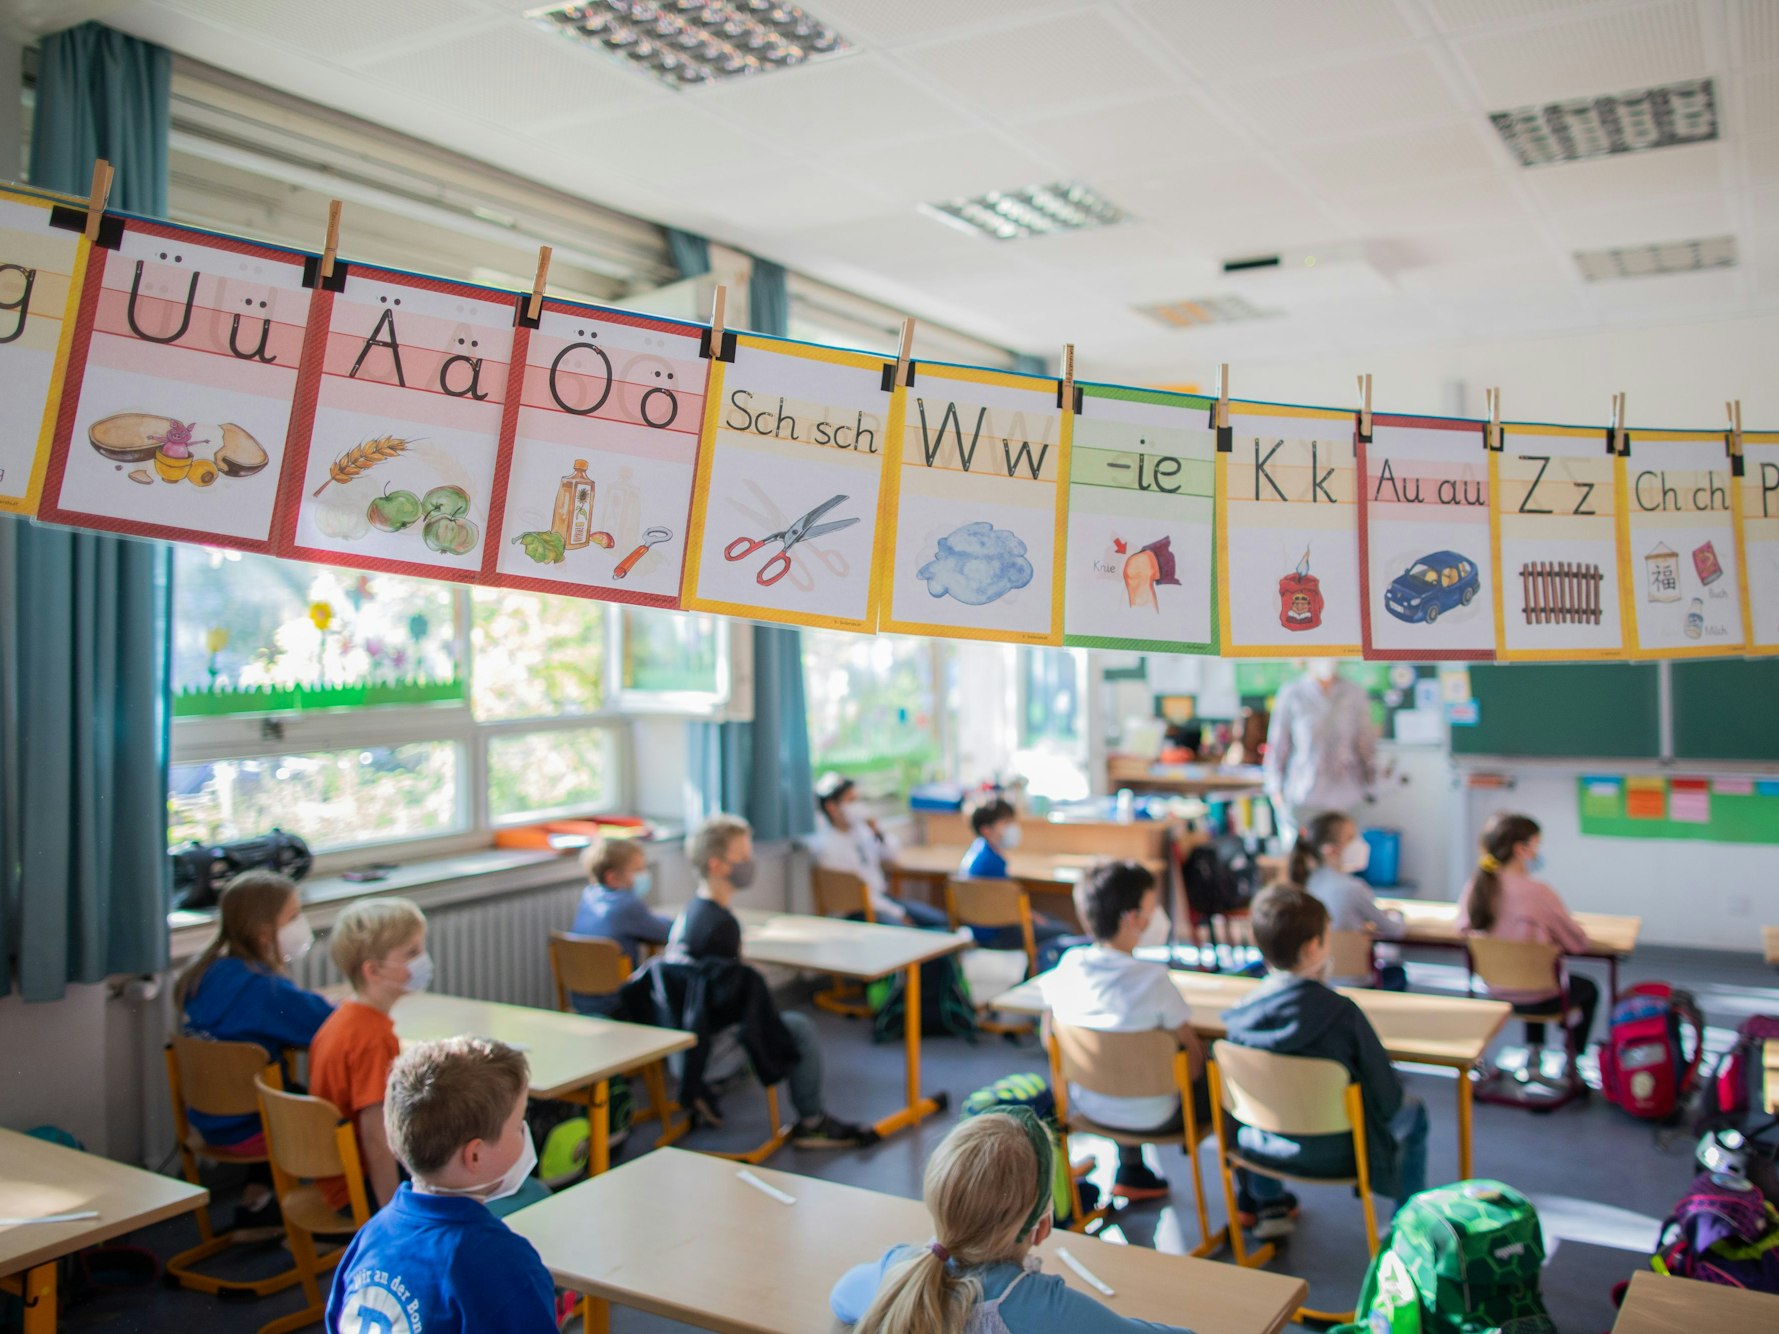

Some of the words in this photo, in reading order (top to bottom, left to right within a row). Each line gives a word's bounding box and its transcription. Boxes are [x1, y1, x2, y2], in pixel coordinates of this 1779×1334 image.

[128, 252, 200, 344] Ü
[230, 298, 277, 363] ü
[349, 296, 406, 387] Ä
[440, 338, 488, 400] ä
[549, 330, 612, 415] Ö
[641, 371, 678, 428] ö
[726, 390, 799, 440] Sch
[814, 411, 877, 453] sch
[917, 398, 987, 472] W
[1003, 439, 1049, 480] w
[1254, 438, 1288, 501] K
[1312, 440, 1337, 503] k
[1374, 458, 1424, 503] Au
[1438, 479, 1485, 505] au
[1518, 455, 1553, 514] Z
[1573, 482, 1596, 515] z
[1635, 470, 1682, 511] Ch
[1693, 470, 1730, 511] ch
[1760, 462, 1779, 518] P
[1093, 559, 1116, 574] Knie
[1652, 564, 1676, 592] 福
[373, 1269, 389, 1285] an
[390, 1275, 410, 1302] der
